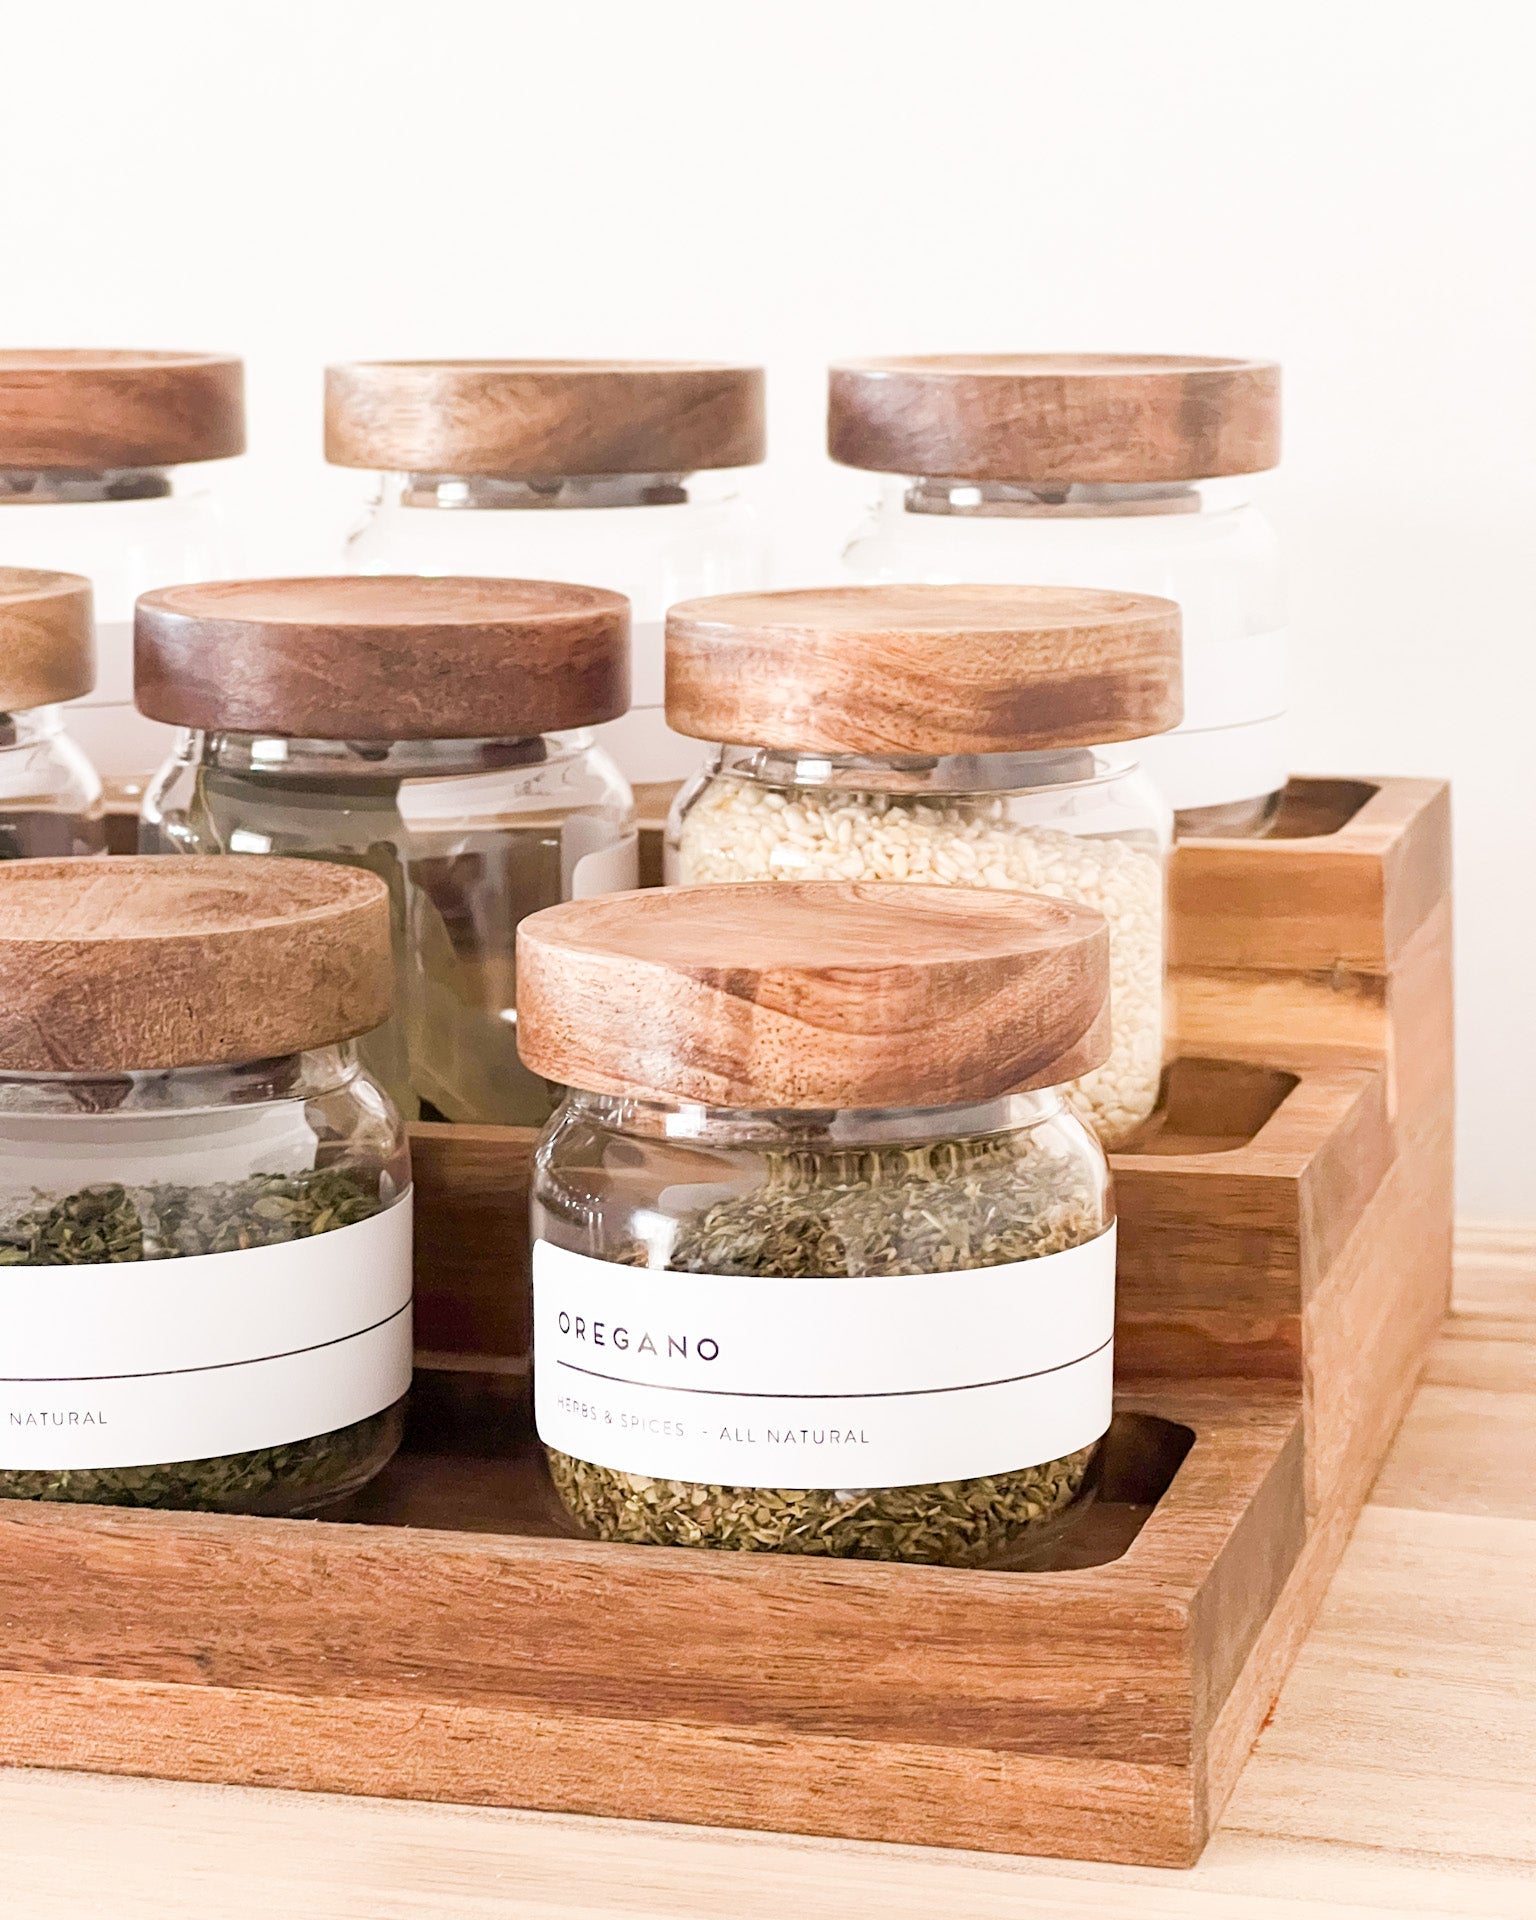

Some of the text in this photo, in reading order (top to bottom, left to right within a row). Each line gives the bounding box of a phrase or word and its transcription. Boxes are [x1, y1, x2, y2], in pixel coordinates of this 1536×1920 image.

[558, 1311, 719, 1361] OREGANO
[10, 1411, 108, 1426] NATURAL
[557, 1396, 598, 1422] HERBS
[604, 1410, 613, 1425] &
[620, 1413, 684, 1438] SPICES
[719, 1427, 756, 1444] ALL
[767, 1429, 870, 1445] NATURAL
